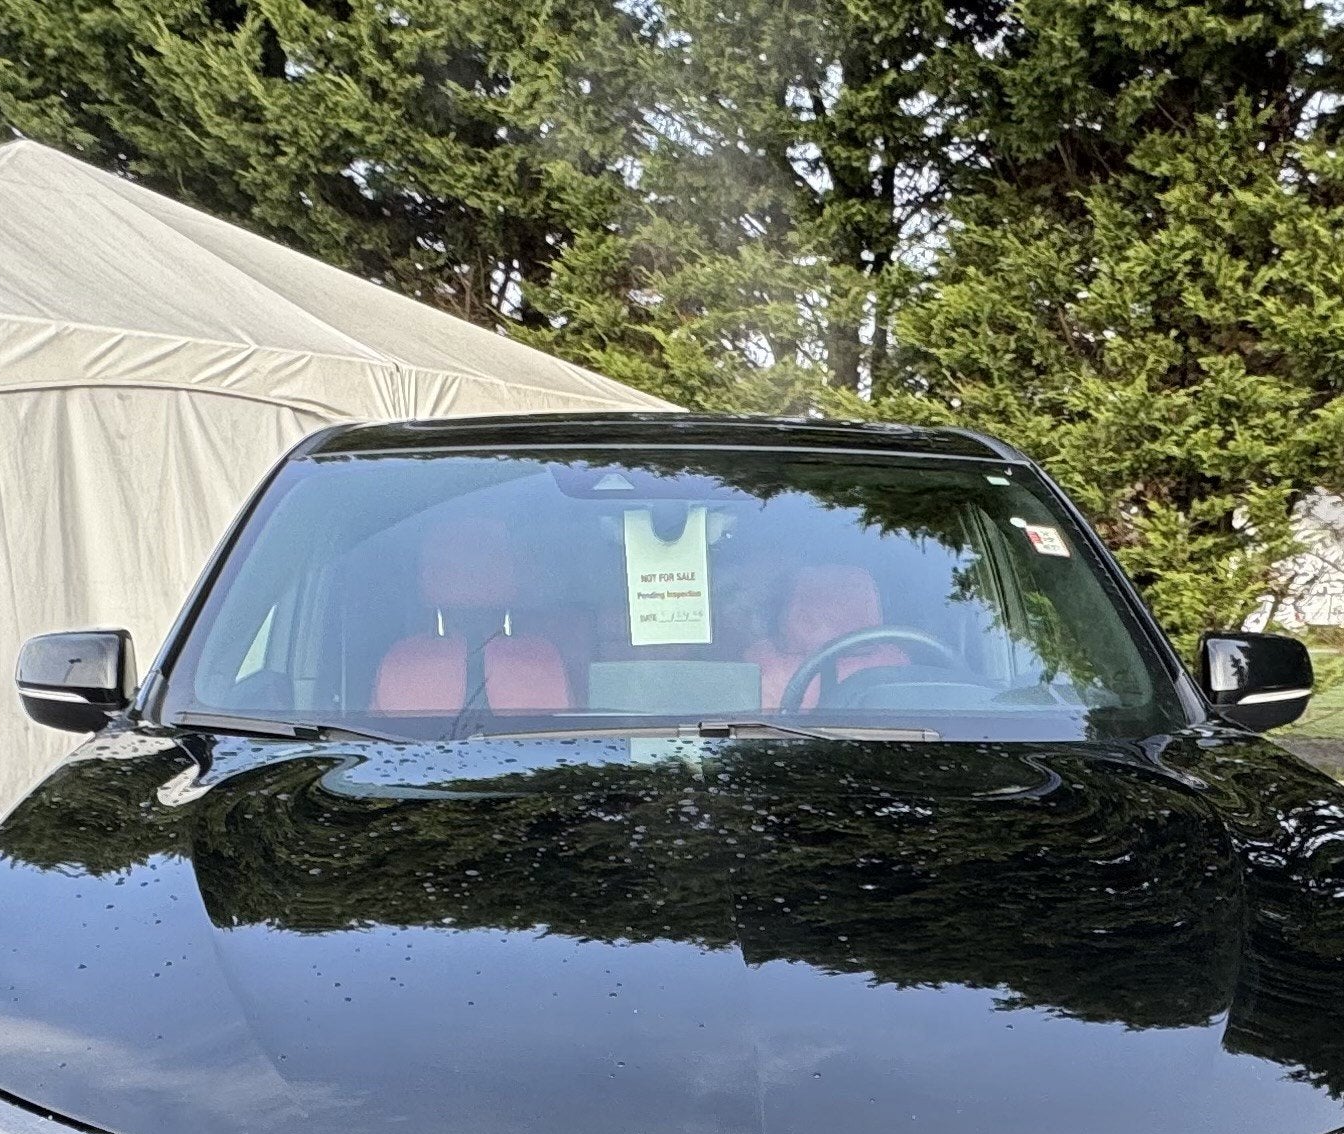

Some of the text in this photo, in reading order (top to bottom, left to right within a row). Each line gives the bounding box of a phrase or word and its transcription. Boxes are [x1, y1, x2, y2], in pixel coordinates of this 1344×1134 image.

[641, 572, 695, 582] NOT FOR SALE
